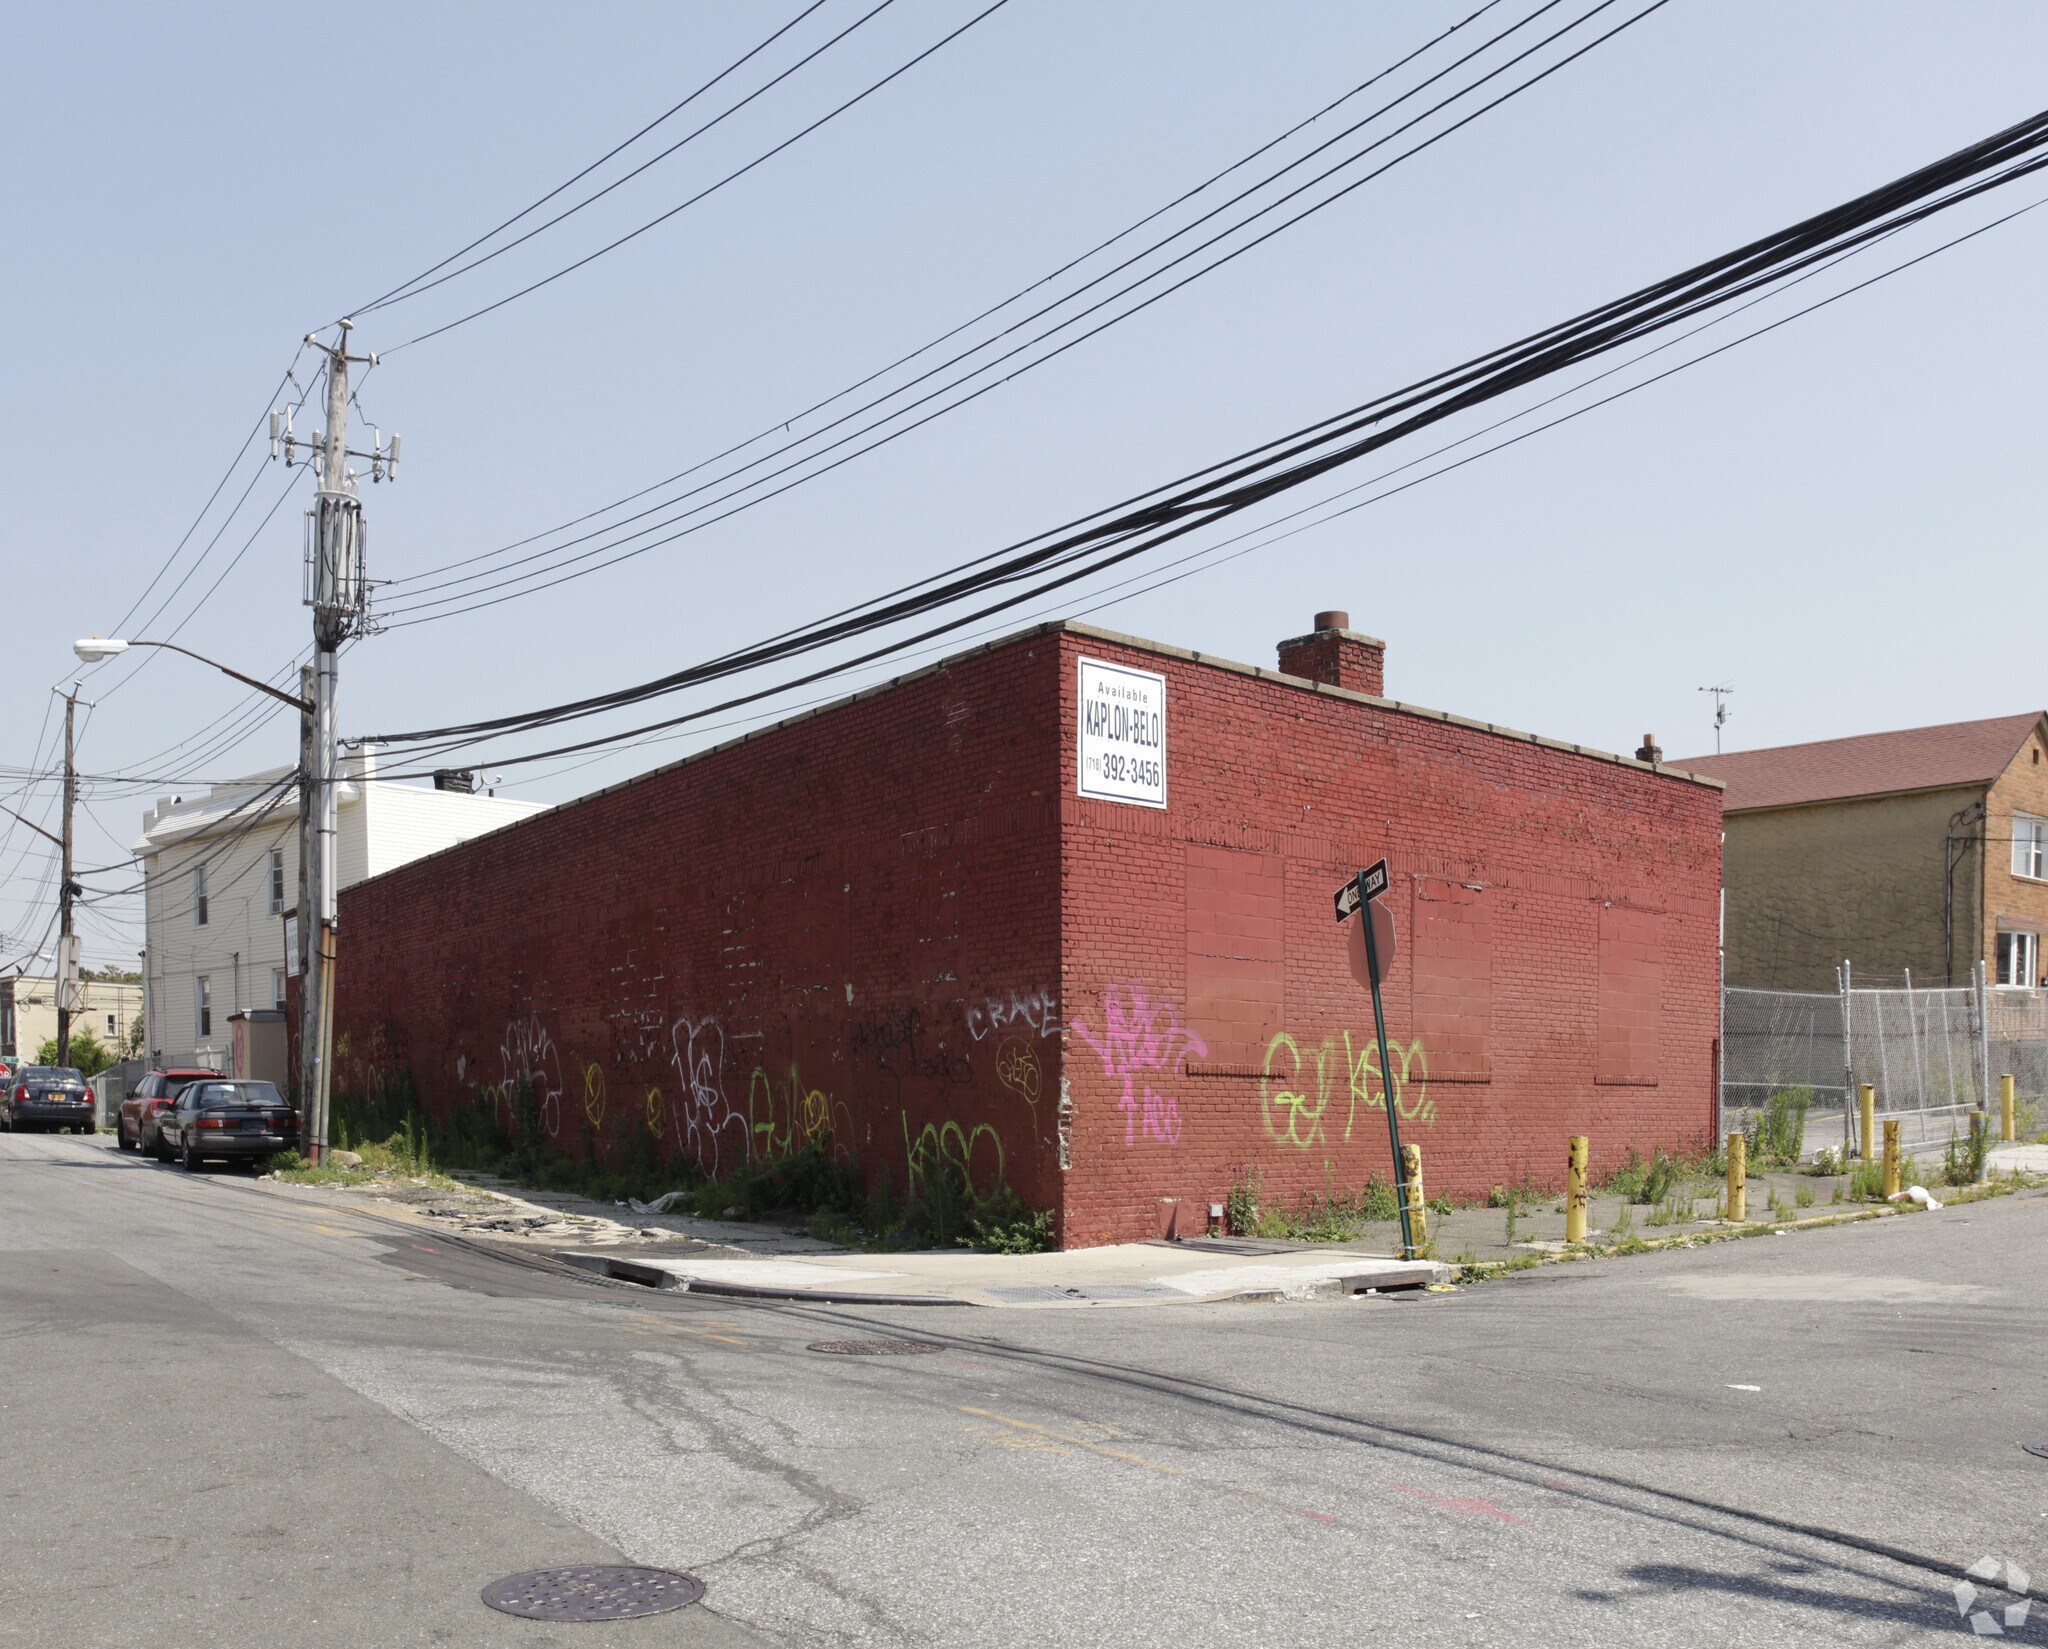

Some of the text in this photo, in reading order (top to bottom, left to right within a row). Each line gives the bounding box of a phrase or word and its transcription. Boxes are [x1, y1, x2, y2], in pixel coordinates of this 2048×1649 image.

[1098, 681, 1148, 703] Available
[1086, 753, 1160, 787] (718) 392-3456
